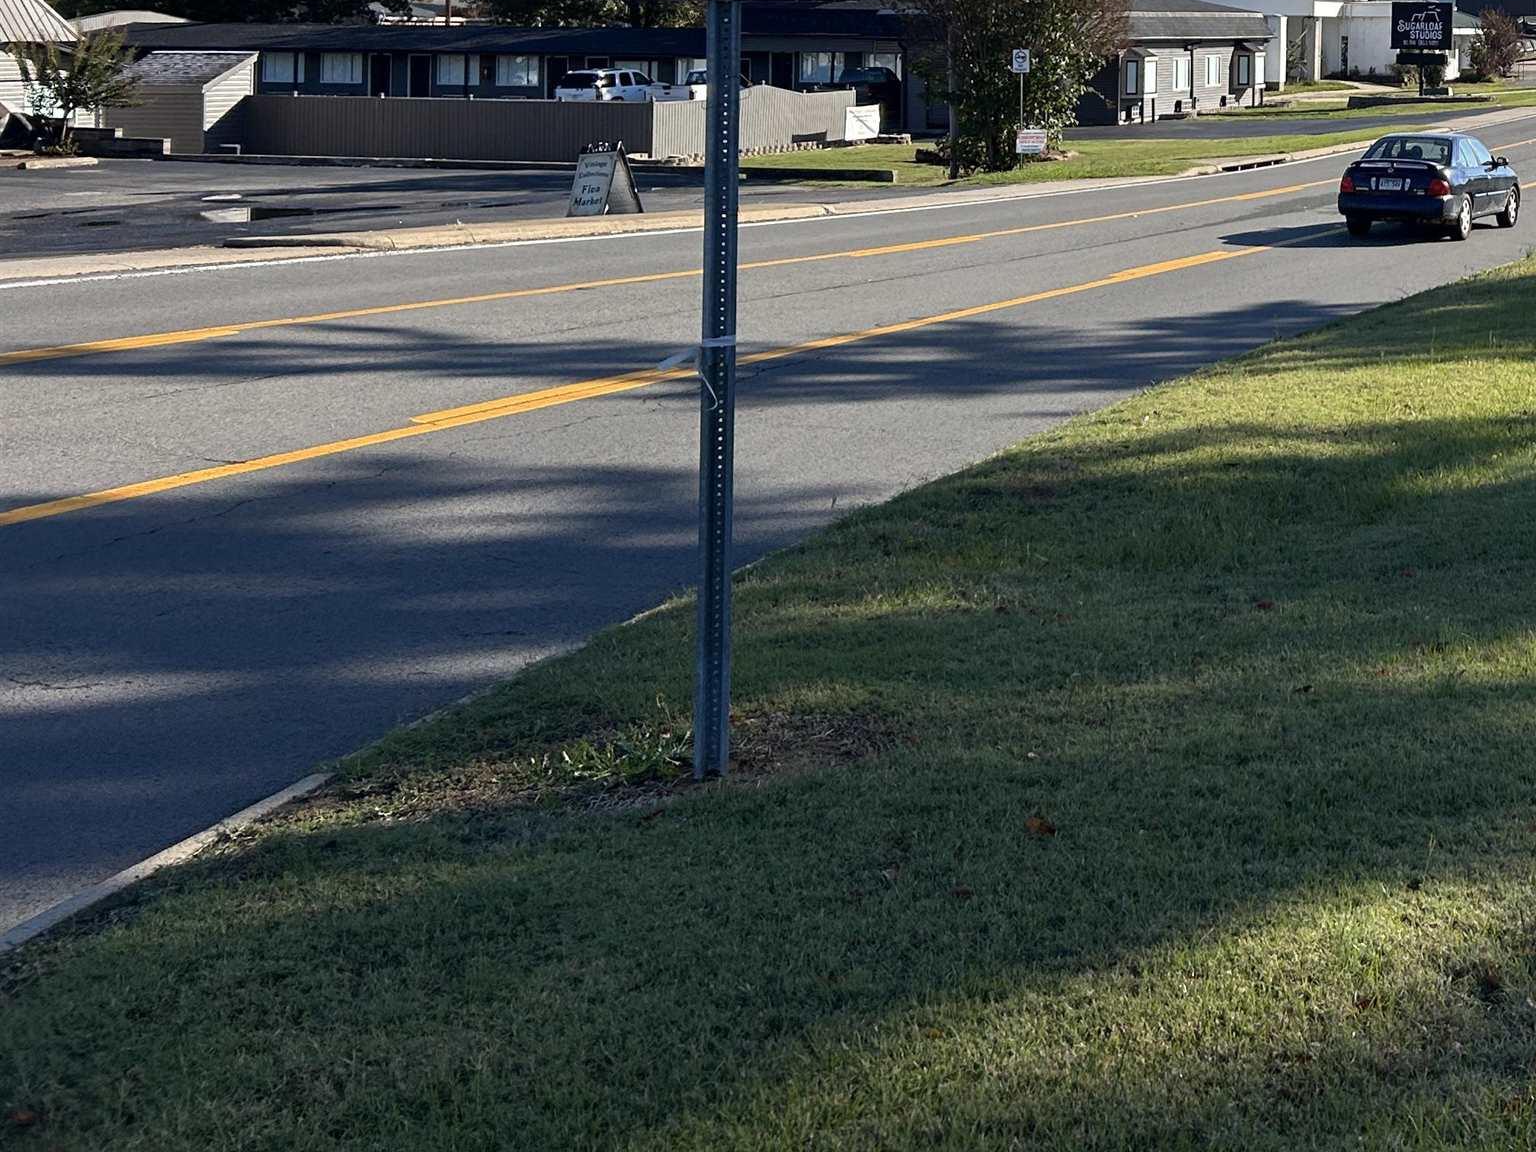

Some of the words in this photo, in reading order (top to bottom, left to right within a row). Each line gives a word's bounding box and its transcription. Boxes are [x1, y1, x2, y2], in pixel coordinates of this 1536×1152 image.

[1397, 19, 1443, 33] SUGARLOAF
[1410, 30, 1443, 40] STUDIOS
[581, 184, 601, 195] Flea
[573, 196, 603, 207] Market
